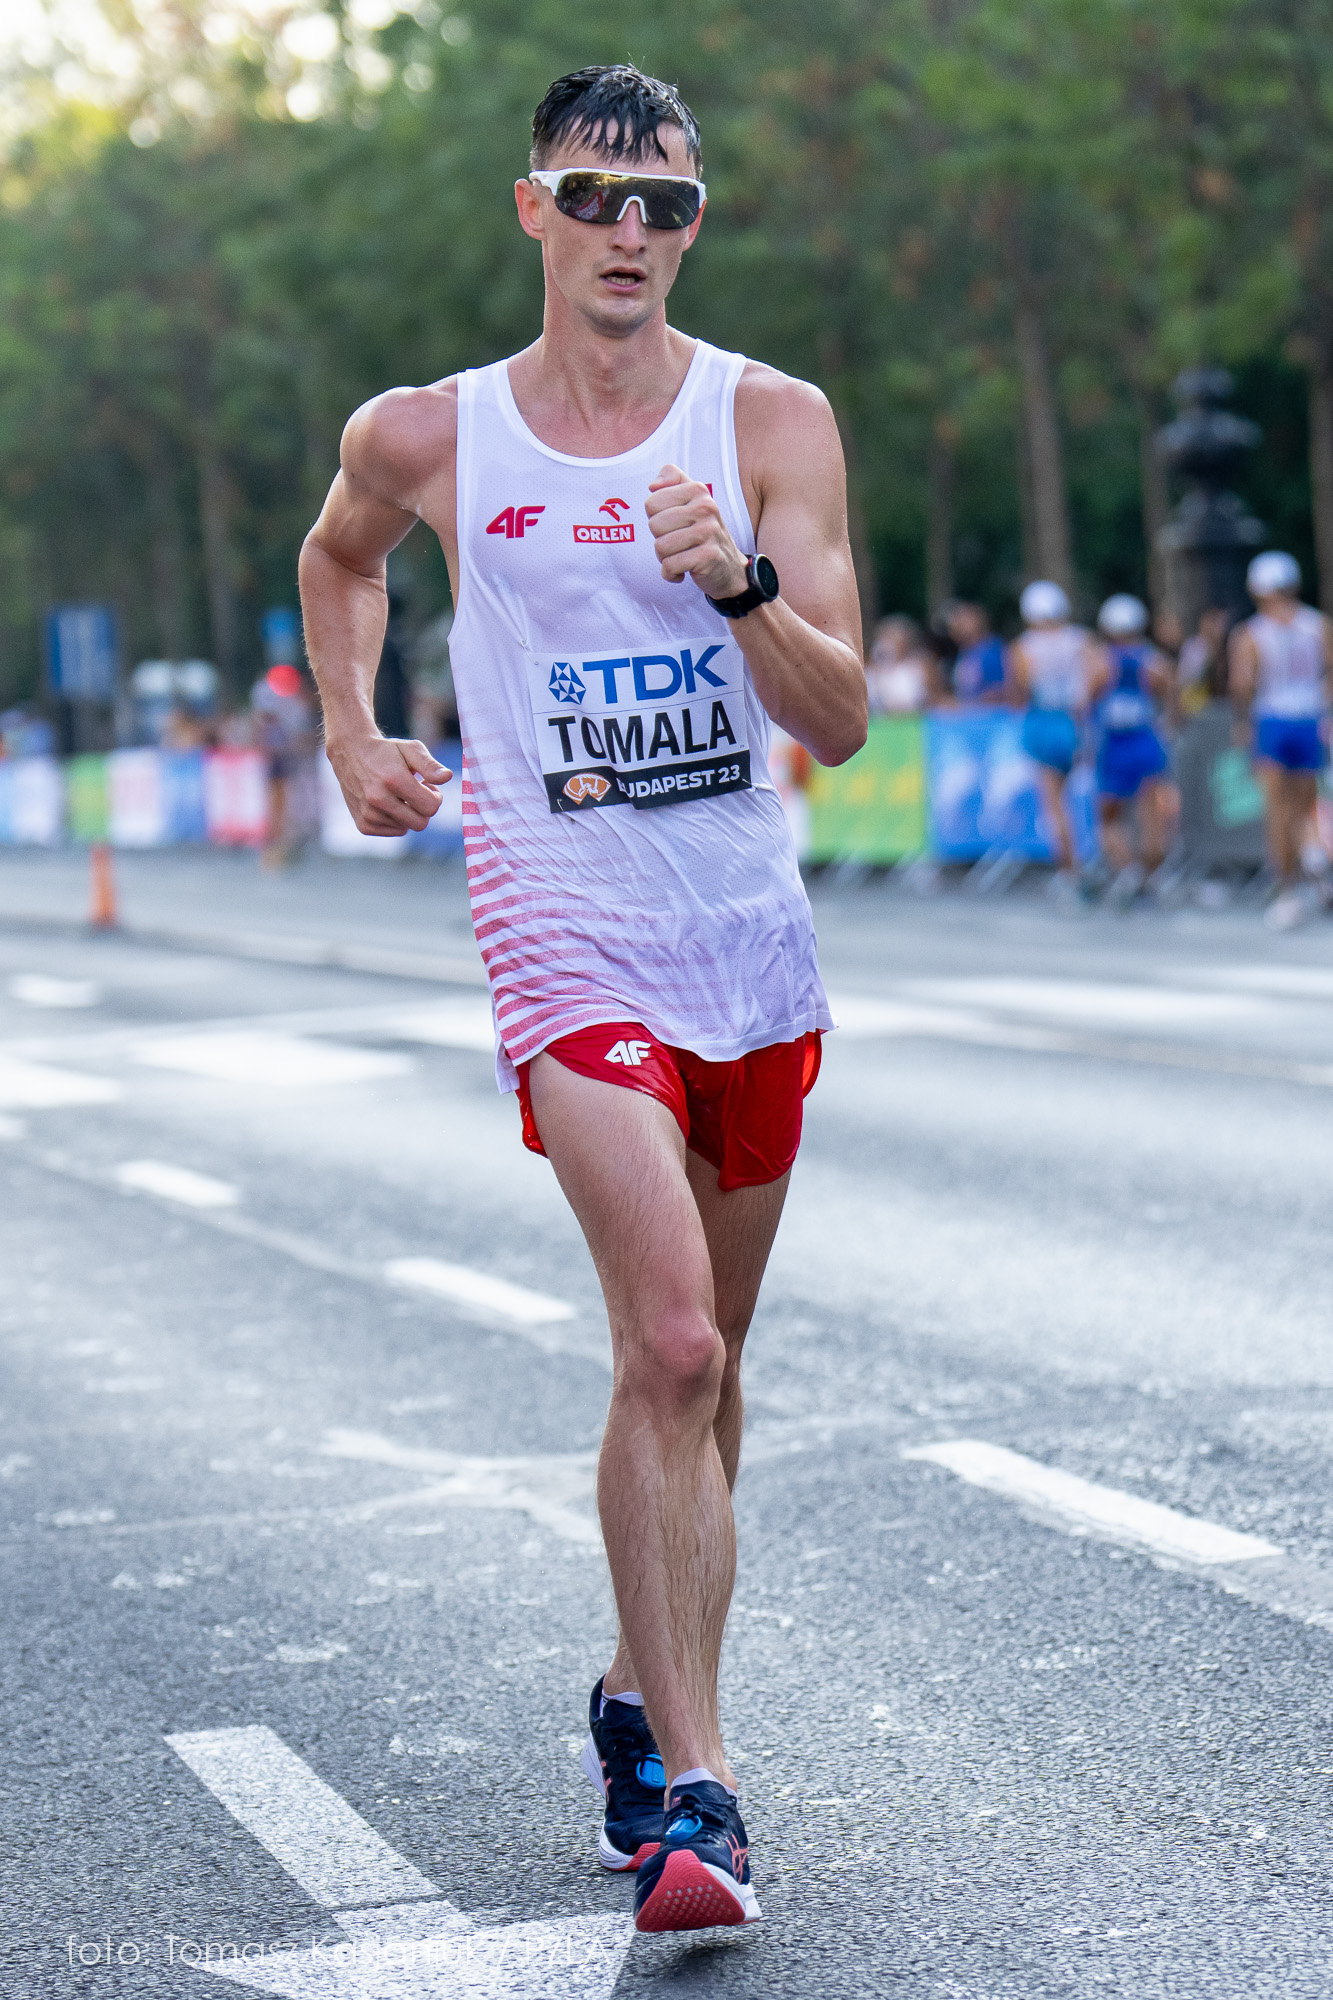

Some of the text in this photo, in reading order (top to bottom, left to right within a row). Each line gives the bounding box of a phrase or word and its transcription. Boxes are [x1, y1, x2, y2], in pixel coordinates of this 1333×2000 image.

[485, 505, 546, 539] 4F
[577, 526, 632, 542] ORLEN
[582, 644, 728, 705] TDK
[548, 700, 737, 764] TOMALA
[718, 764, 741, 784] 23
[604, 1040, 651, 1066] 4F
